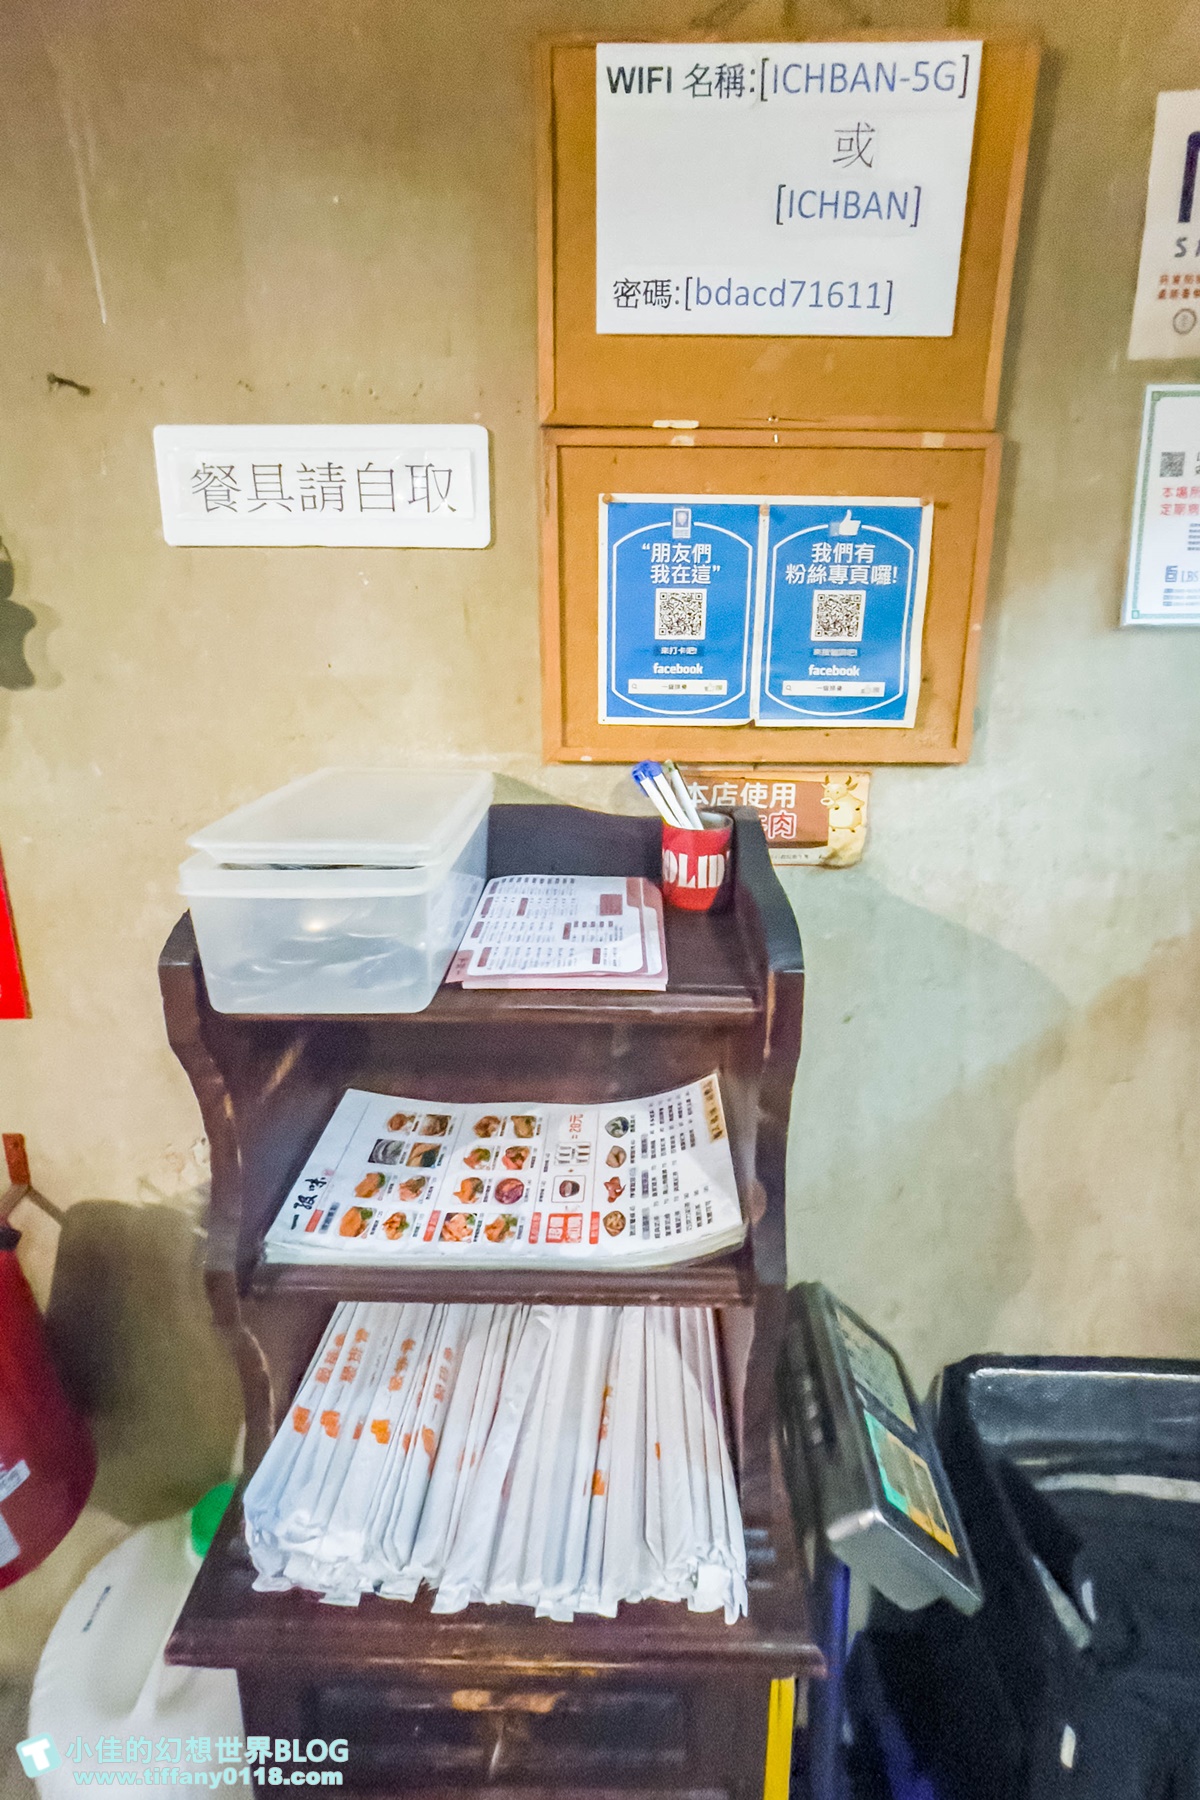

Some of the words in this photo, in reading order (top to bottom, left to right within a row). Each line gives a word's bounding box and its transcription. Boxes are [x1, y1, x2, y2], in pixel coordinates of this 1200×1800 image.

[606, 65, 673, 94] WIFI
[832, 121, 876, 169] 或
[775, 184, 922, 227] [ICHBAN]
[613, 276, 894, 316] 密碼:[bdacd71611]
[191, 462, 456, 513] 餐具請自取
[811, 542, 875, 563] 我們有
[785, 565, 898, 585] 粉絲專頁囉!
[653, 663, 703, 675] facebook
[808, 664, 860, 677] facebook
[689, 782, 797, 808] 本店使用
